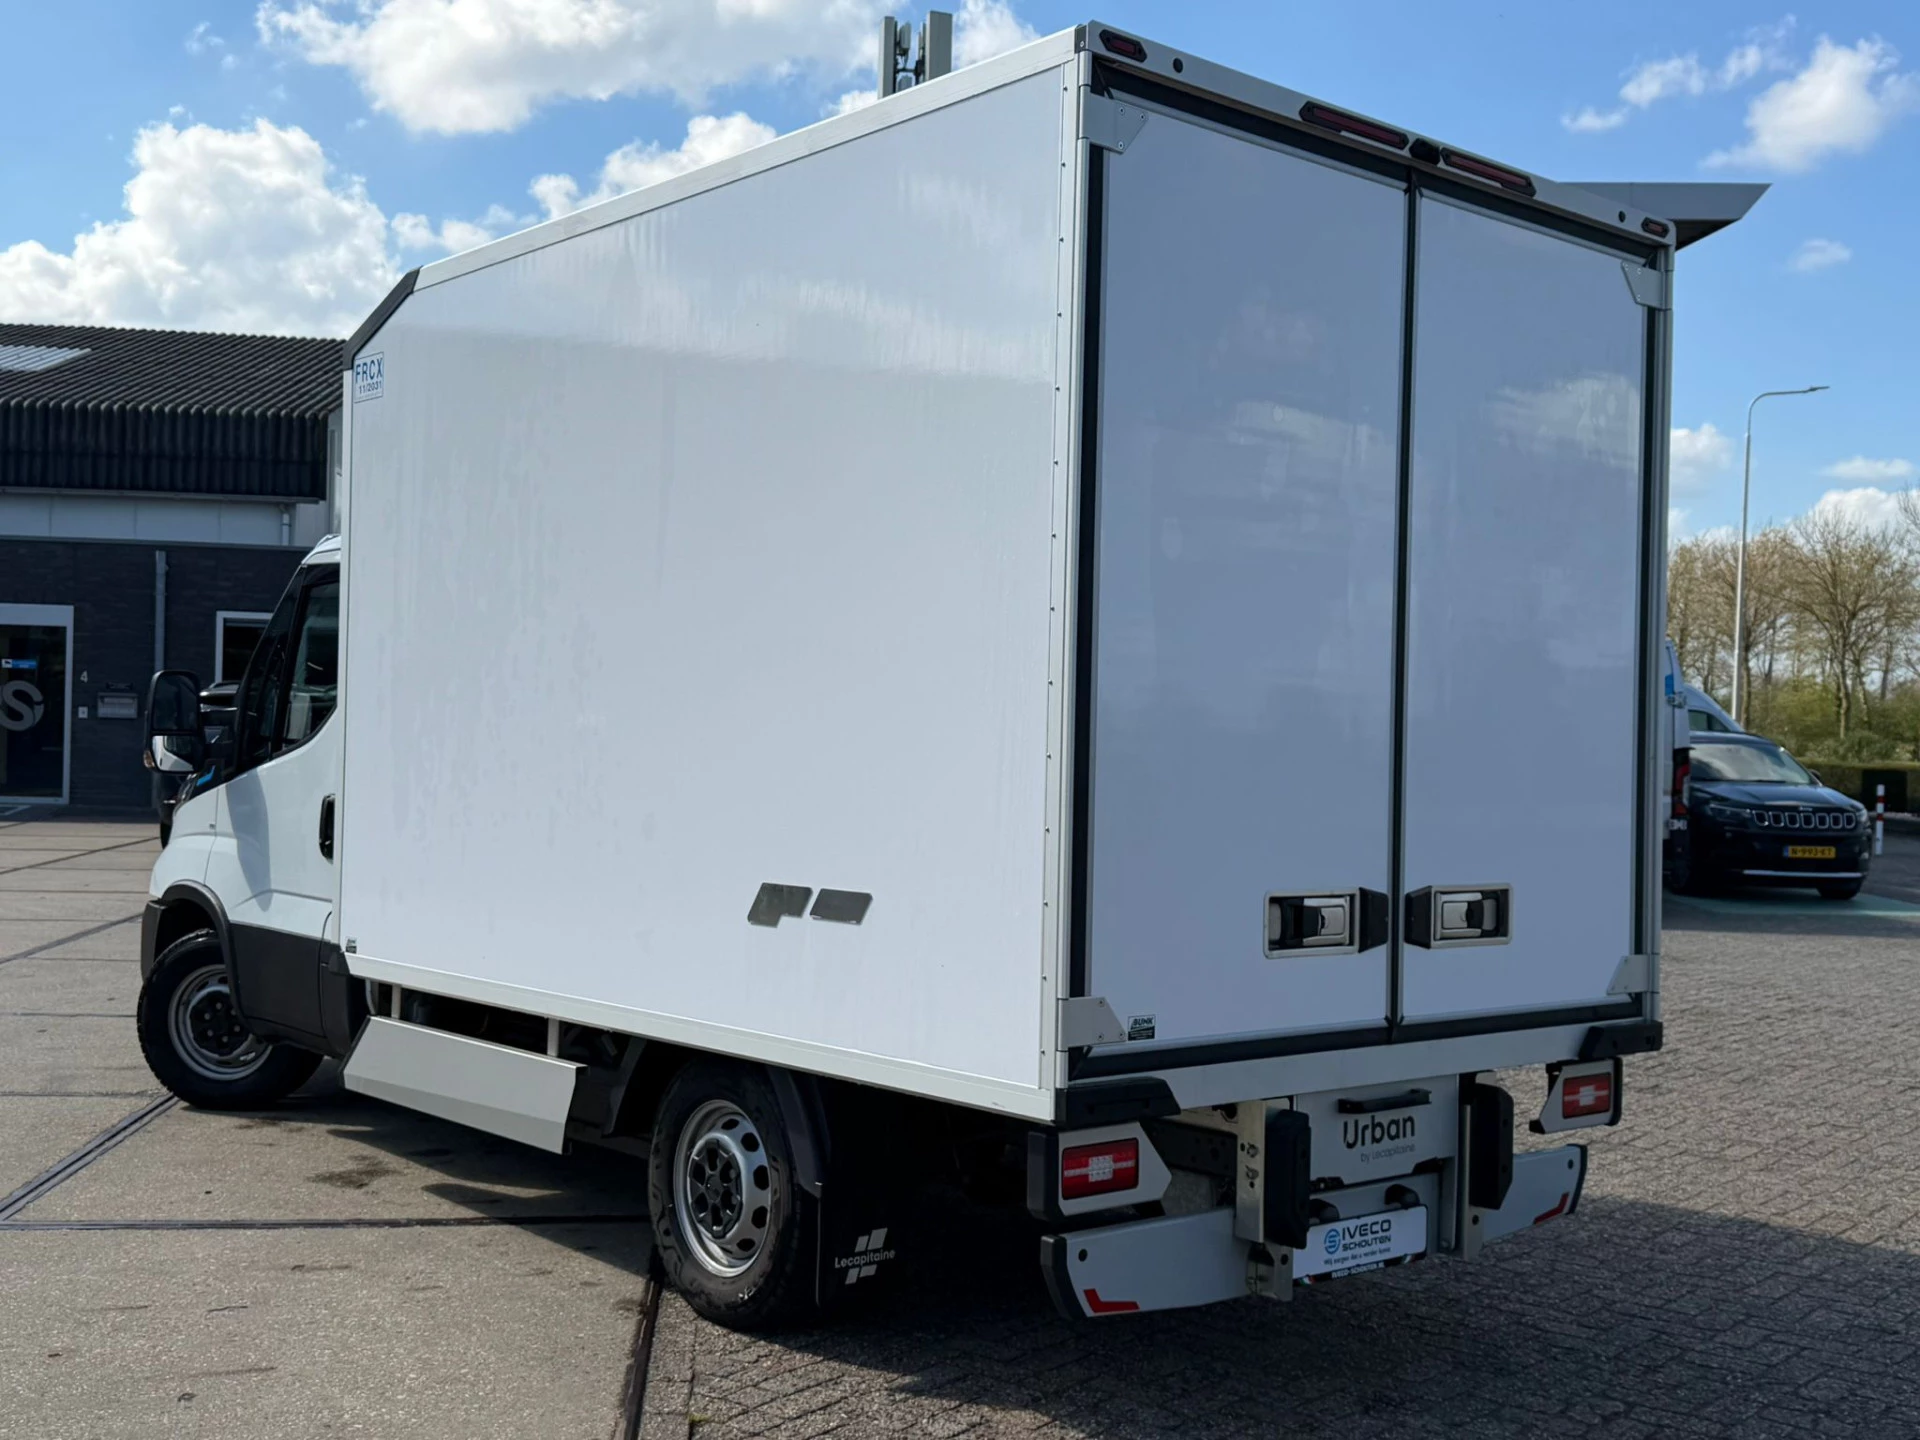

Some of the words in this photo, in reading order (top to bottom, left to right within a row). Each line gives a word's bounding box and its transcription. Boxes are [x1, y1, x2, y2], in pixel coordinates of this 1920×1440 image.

[355, 358, 383, 384] FRCX
[80, 670, 88, 683] 4
[1343, 1114, 1415, 1149] Urban
[1360, 1152, 1370, 1165] by
[1342, 1219, 1392, 1241] IVECO
[1342, 1234, 1392, 1252] SCHOUTEN
[834, 1249, 896, 1269] Lecapitaine
